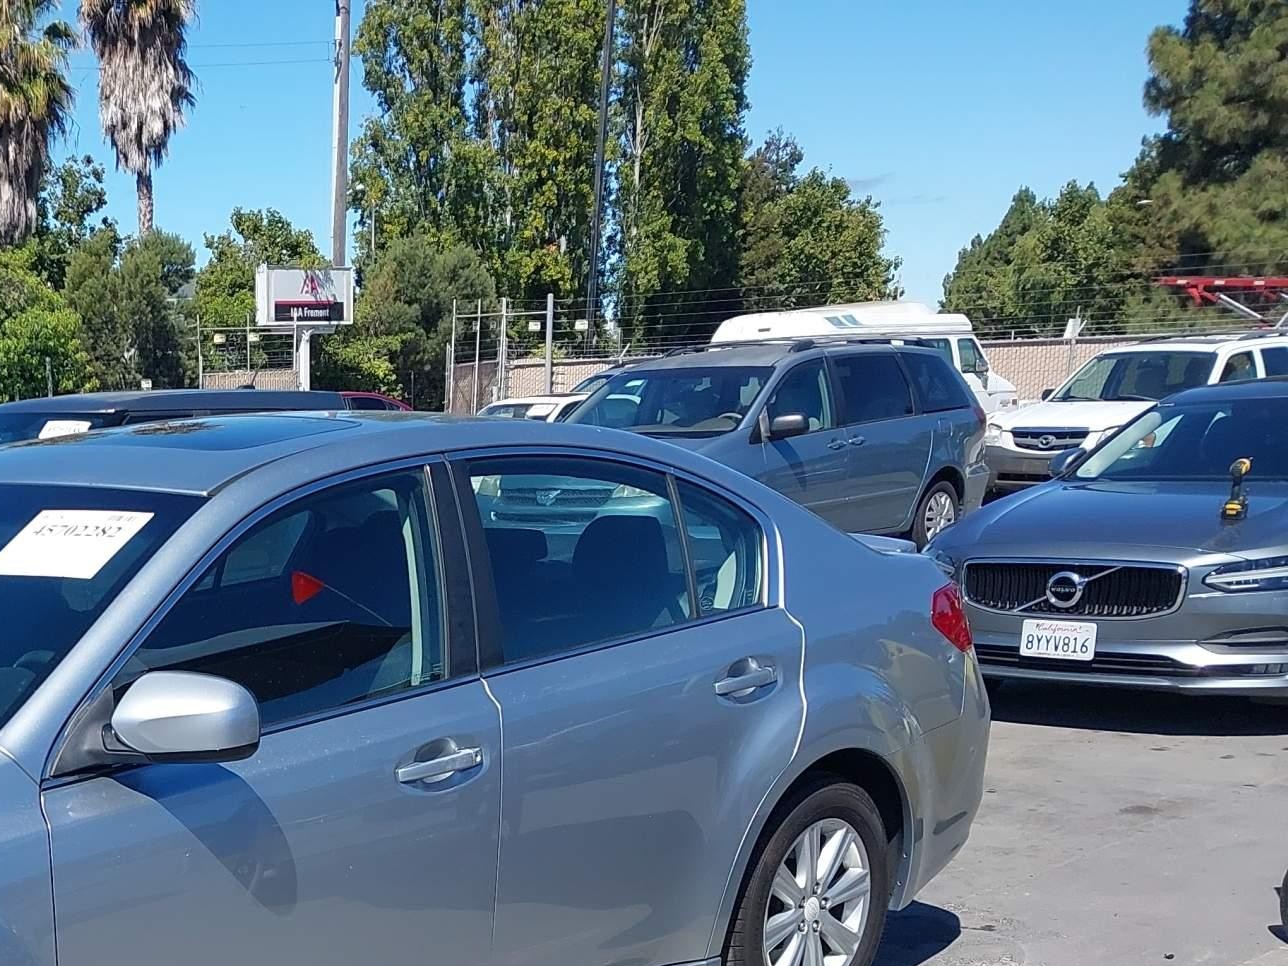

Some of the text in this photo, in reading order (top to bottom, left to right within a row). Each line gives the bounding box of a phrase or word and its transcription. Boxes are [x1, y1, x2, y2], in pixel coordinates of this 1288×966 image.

[304, 307, 329, 318] Fremont
[33, 524, 123, 538] 45702282
[1036, 623, 1081, 634] California
[1025, 633, 1091, 654] 8YYV816
